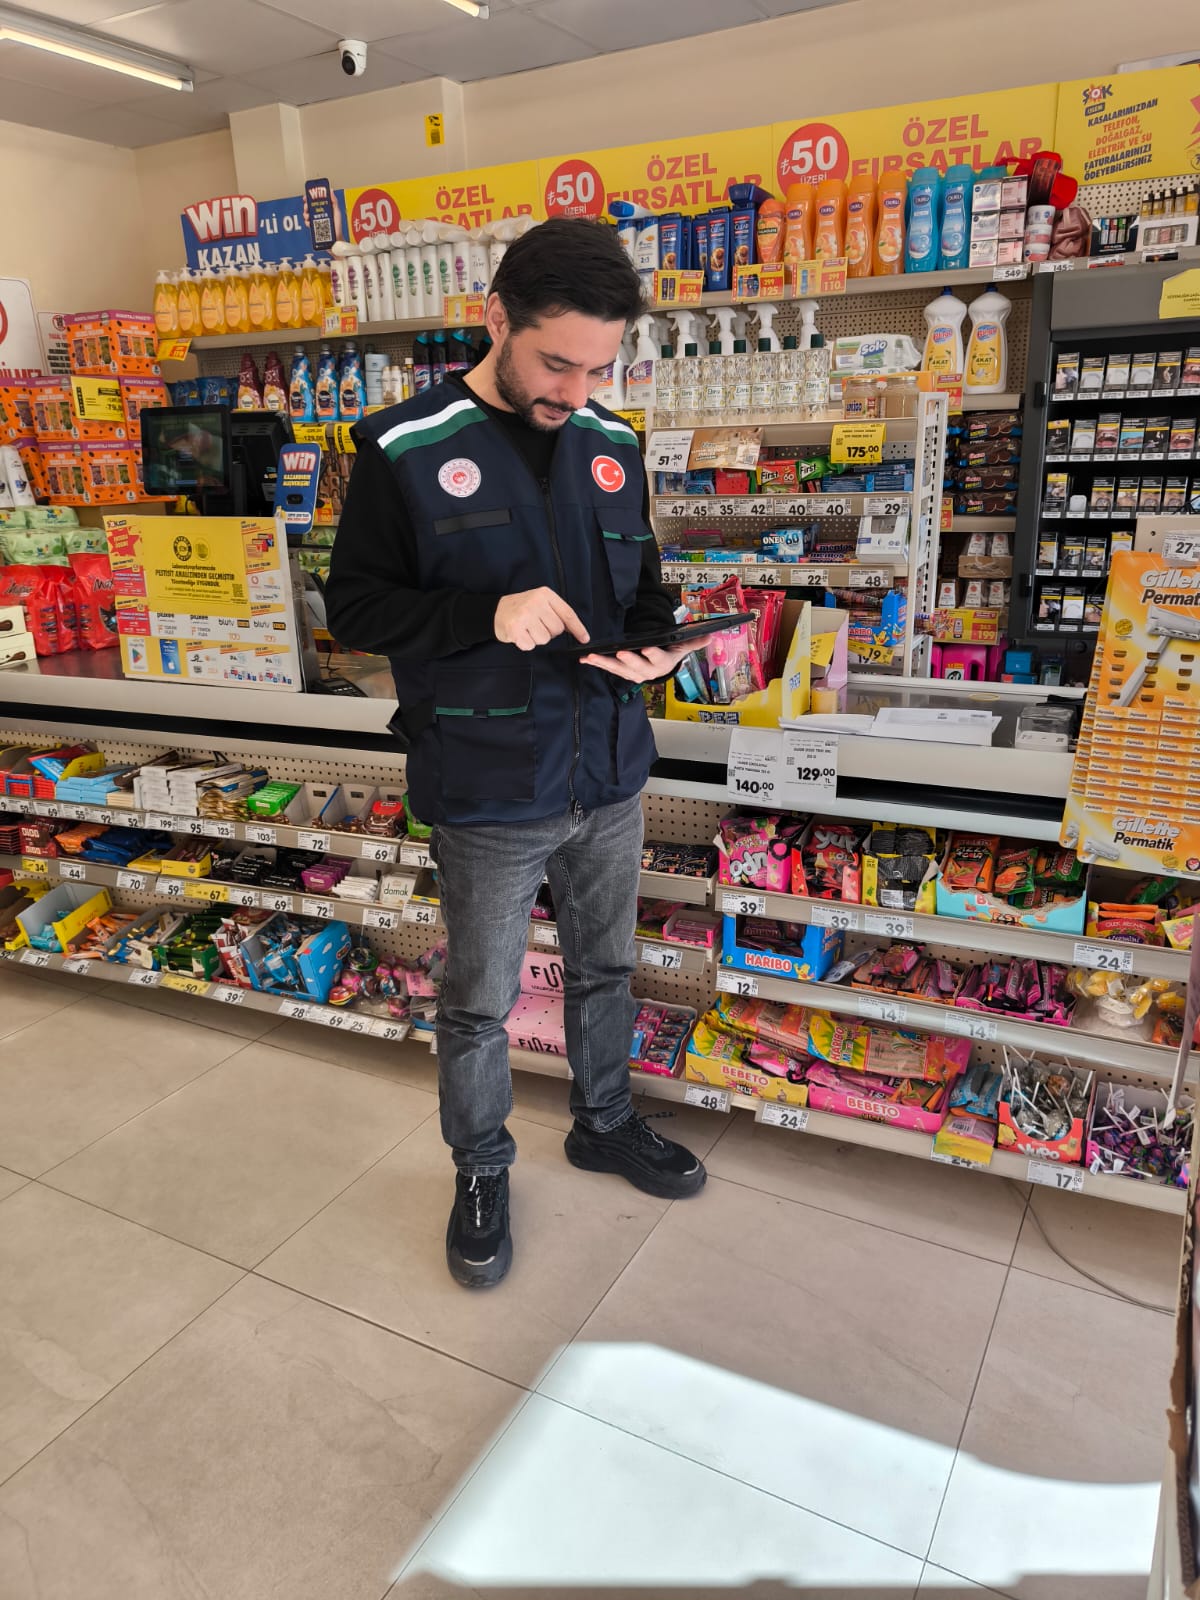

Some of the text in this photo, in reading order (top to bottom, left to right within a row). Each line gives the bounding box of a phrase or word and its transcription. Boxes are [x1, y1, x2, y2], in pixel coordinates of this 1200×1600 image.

[1088, 98, 1158, 127] KASALARIMIZDAN
[902, 113, 989, 147] ÖZEL
[1103, 115, 1140, 133] TELEFON,
[1096, 126, 1142, 146] DOĞALGAZ,
[1128, 136, 1139, 146] VE
[1141, 133, 1152, 144] SU
[1084, 144, 1152, 170] FATURALARINIZI
[646, 152, 717, 183] ÖZEL
[1084, 154, 1152, 181] ÖDEYEBİLİRSİNİZ
[435, 183, 494, 211] ÖZEL
[563, 204, 587, 217] ÜZERİ
[283, 215, 302, 232] OL
[197, 242, 262, 269] KAZAN
[861, 339, 888, 357] Solo
[761, 471, 779, 482] First
[671, 505, 684, 517] 47
[693, 505, 707, 517] 45
[720, 504, 734, 515] 35
[750, 504, 766, 515] 42
[789, 504, 806, 516] 40
[826, 504, 844, 515] 40
[884, 503, 901, 514] 29
[1175, 541, 1194, 554] 27
[759, 573, 775, 585] 46
[807, 573, 822, 585] 22
[865, 575, 882, 586] 48
[848, 627, 872, 635] ARIBO
[869, 647, 881, 660] 19
[128, 817, 138, 827] 52
[159, 819, 172, 829] 199
[1112, 816, 1181, 839] Gillette
[190, 823, 202, 834] 95
[217, 827, 229, 836] 123
[257, 832, 271, 842] 103
[1113, 831, 1176, 851] Permatik
[312, 839, 323, 850] 72
[375, 850, 388, 861] 69
[34, 863, 45, 872] 34
[69, 869, 80, 879] 44
[129, 879, 141, 889] 70
[168, 884, 180, 895] 59
[210, 890, 220, 900] 67
[241, 895, 253, 906] 69
[274, 900, 287, 910] 69
[740, 902, 757, 914] 39
[316, 906, 328, 917] 72
[416, 911, 430, 923] 54
[378, 916, 392, 928] 94
[831, 915, 849, 929] 39
[885, 923, 905, 938] 39
[661, 953, 674, 967] 17
[745, 951, 792, 973] HARIBO
[77, 963, 84, 973] 8
[140, 974, 153, 984] 45
[737, 981, 750, 994] 12
[225, 991, 239, 1002] 39
[291, 1007, 305, 1018] 28
[881, 1006, 897, 1021] 14
[329, 1015, 343, 1027] 69
[352, 1020, 365, 1032] 25
[383, 1027, 398, 1039] 39
[968, 1022, 986, 1038] 14
[831, 1026, 845, 1061] HARIBO
[722, 1063, 770, 1087] BEBETO
[701, 1095, 718, 1110] 48
[846, 1095, 900, 1119] BEBETO
[780, 1113, 798, 1128] 24
